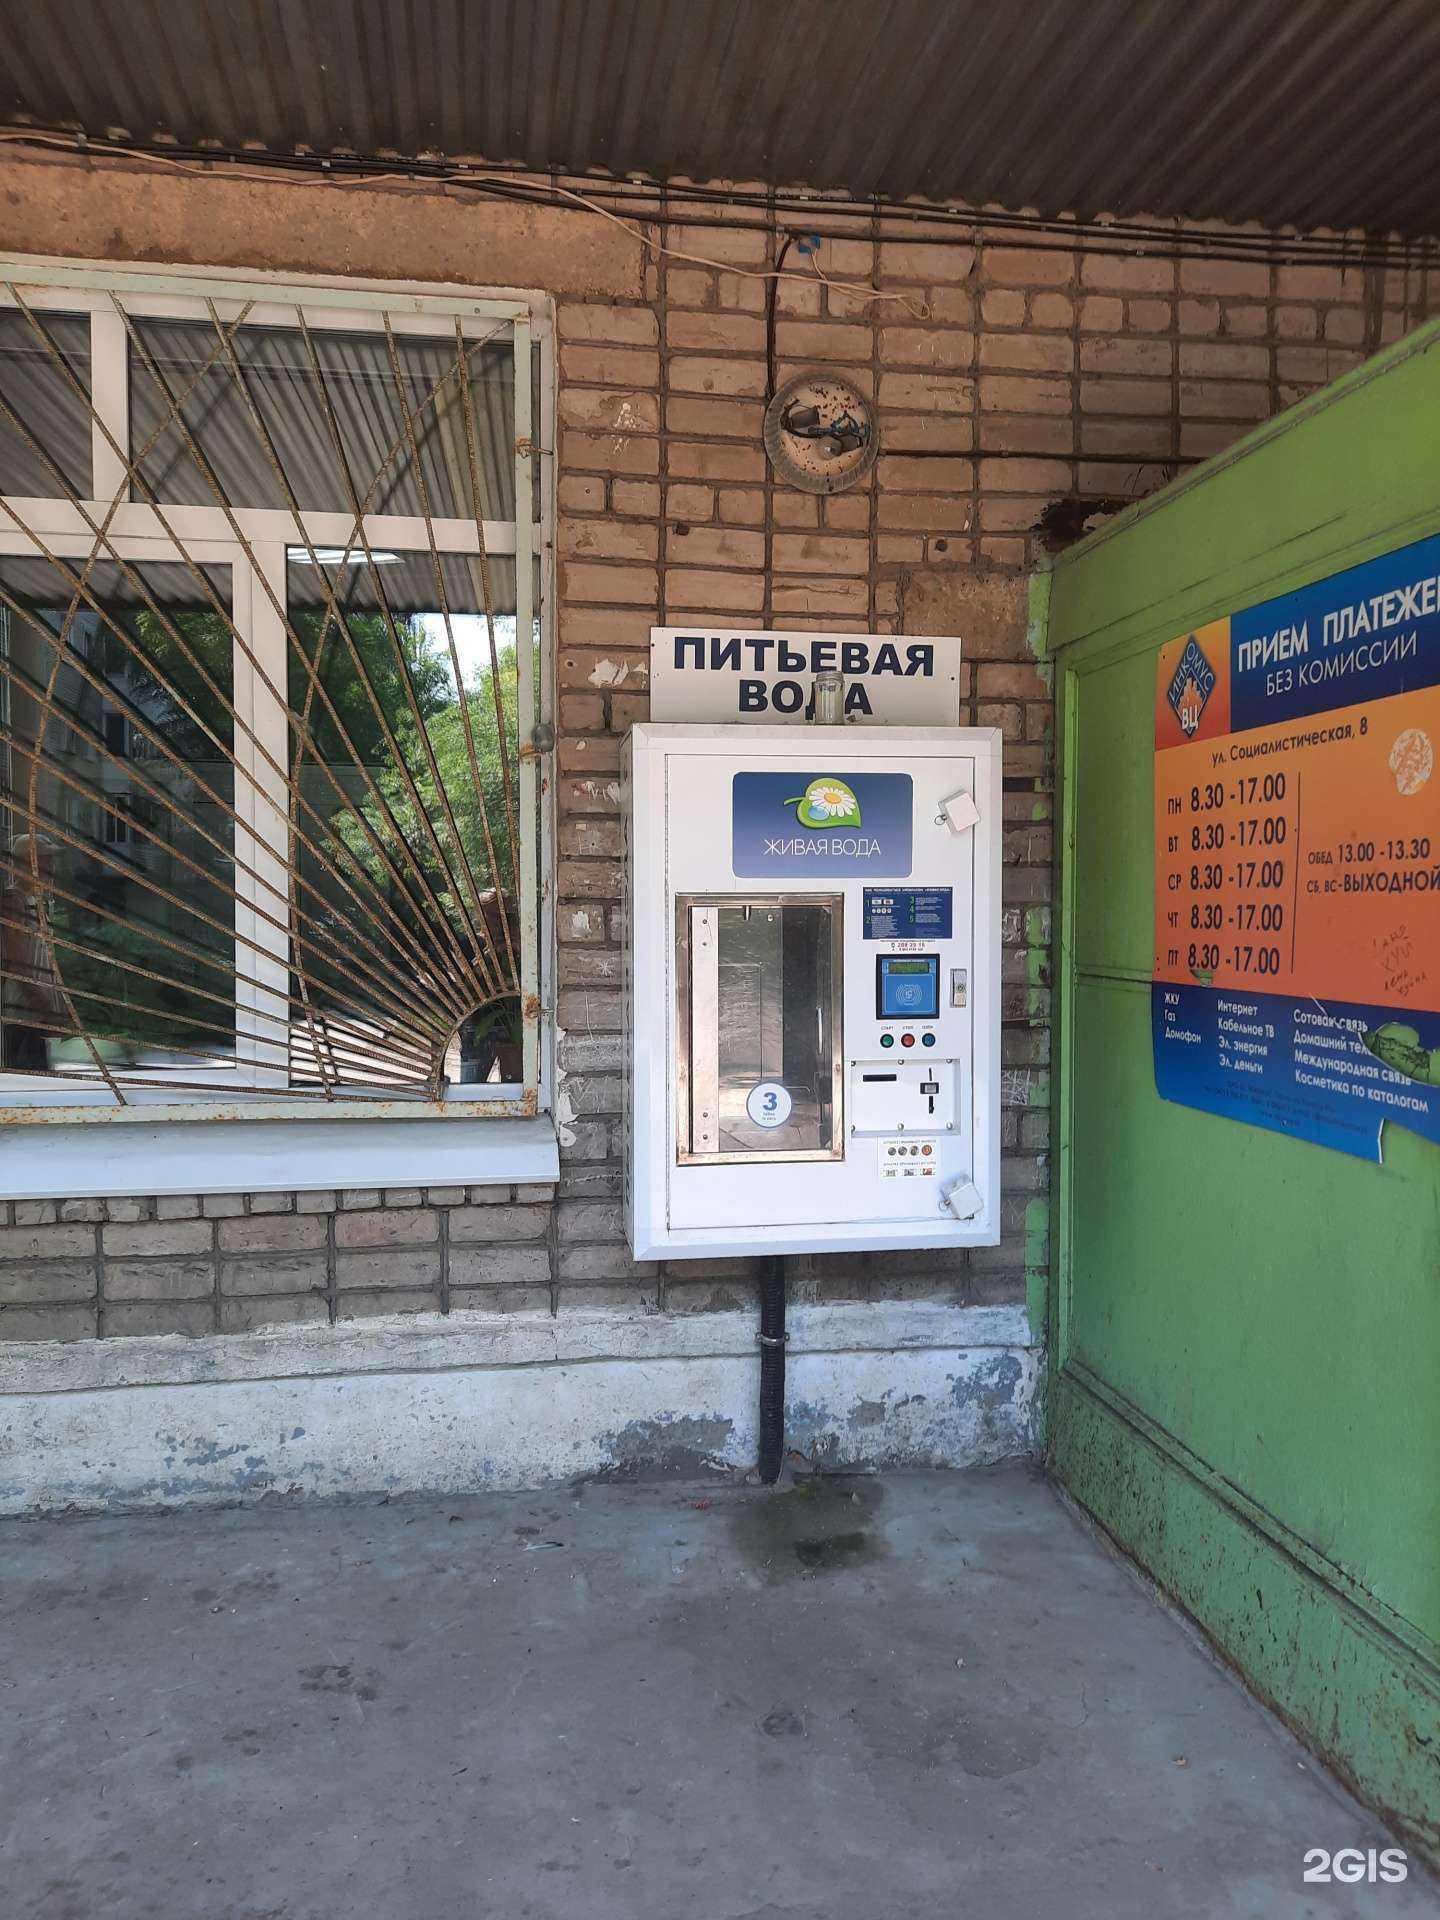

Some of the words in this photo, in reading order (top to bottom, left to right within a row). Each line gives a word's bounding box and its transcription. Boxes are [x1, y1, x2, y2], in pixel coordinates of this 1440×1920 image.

[1238, 619, 1309, 672] ПРИЕМ
[1323, 575, 1440, 646] ПЛАТЕЖЕ
[674, 636, 934, 676] ПИТЬЕВАЯ
[1266, 669, 1293, 696] БЕЗ
[1299, 630, 1418, 687] КОМИССИИ
[1182, 704, 1199, 730] ВЦ
[1211, 749, 1227, 768] ул.
[1230, 722, 1355, 761] Социалистическая,
[1359, 716, 1368, 735] 8
[1168, 798, 1182, 815] ПН
[763, 838, 828, 856] ЖИВАЯ
[832, 838, 881, 857] ВОДА
[1168, 836, 1178, 852] ВТ
[1308, 851, 1333, 864] ОБЕД
[1168, 873, 1182, 890] СР
[1168, 911, 1178, 928] ЧТ
[1167, 949, 1178, 965] ПТ
[1164, 992, 1180, 1006] ЖКУ
[1217, 999, 1258, 1017] Интернет
[1164, 1010, 1176, 1022] Газ
[1336, 1016, 1368, 1033] связь
[1165, 1027, 1201, 1044] Домофон
[1218, 1018, 1263, 1036] Кабельное
[1265, 1024, 1275, 1038] ТВ
[1218, 1036, 1232, 1050] Эл.
[1233, 1041, 1268, 1057] энергия
[1293, 1030, 1347, 1051] Домашний
[1219, 1054, 1232, 1068] Эл.
[1233, 1059, 1263, 1075] деньги
[1294, 1049, 1379, 1080] Международная
[1295, 1069, 1349, 1095] Косметика
[1351, 1083, 1365, 1098] по
[1367, 1089, 1429, 1114] каталогам
[763, 1092, 778, 1111] 3
